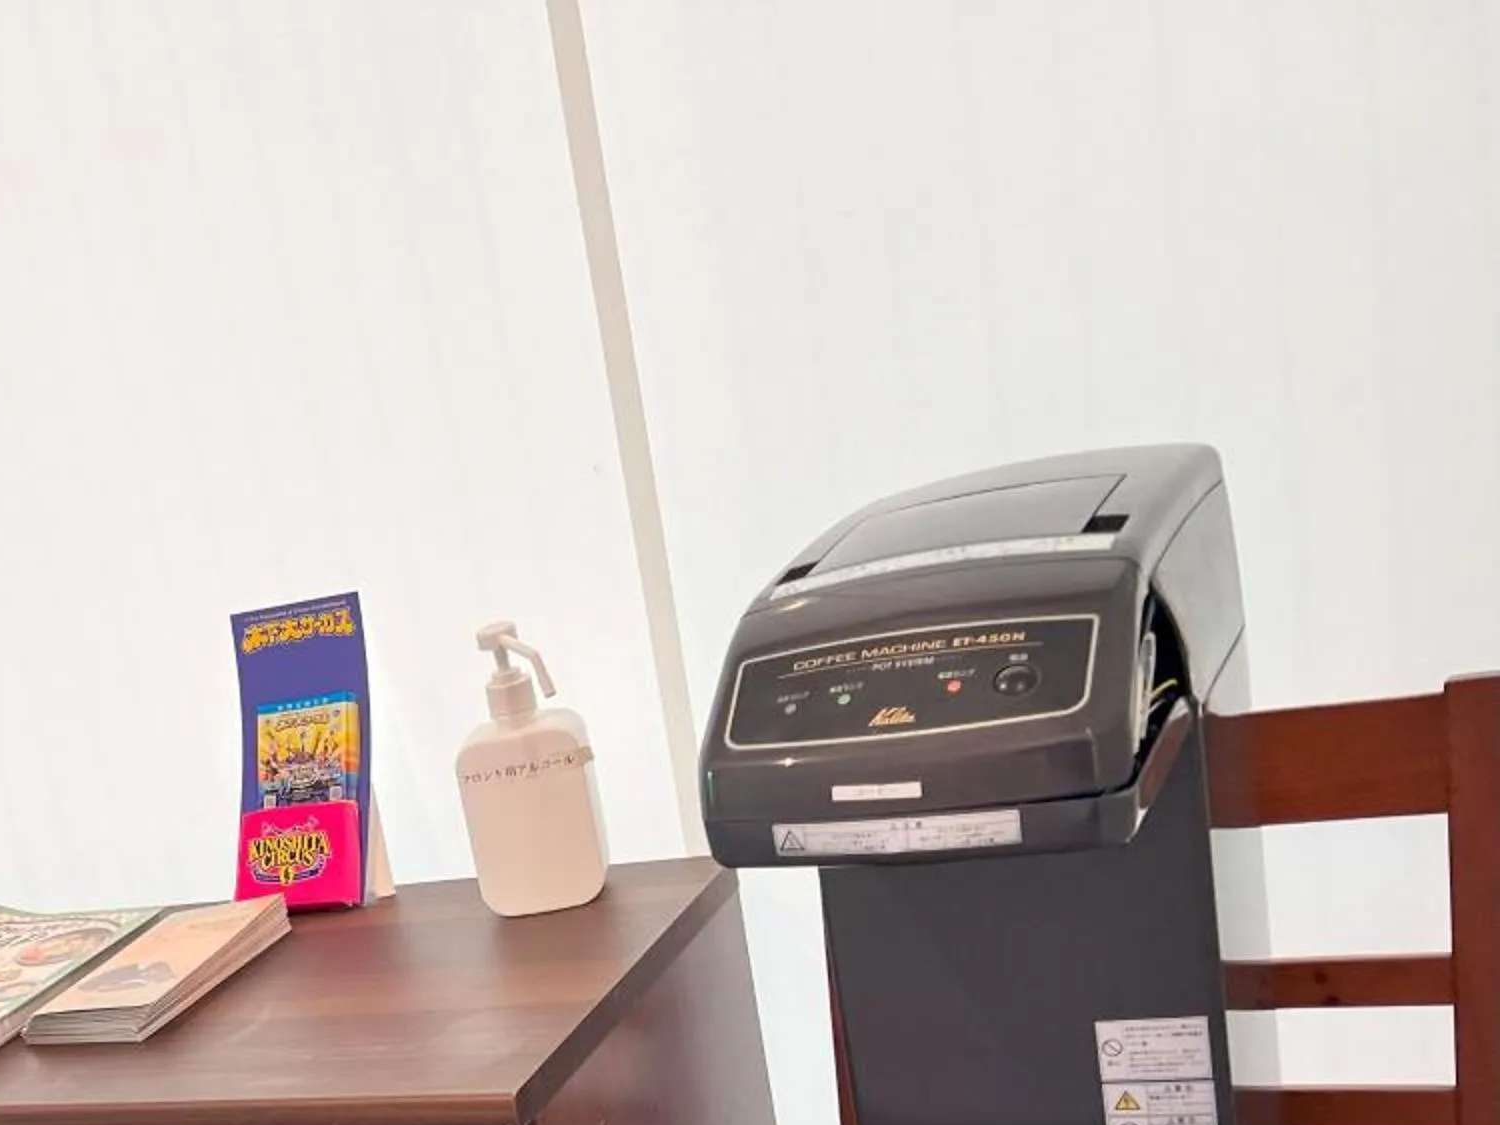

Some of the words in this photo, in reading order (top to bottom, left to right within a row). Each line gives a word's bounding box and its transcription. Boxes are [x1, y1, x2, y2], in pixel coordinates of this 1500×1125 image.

[793, 652, 856, 672] COFFEE
[860, 638, 947, 660] MACHINE
[248, 831, 331, 861] KINOSHITA
[261, 849, 315, 871] CIRCUS
